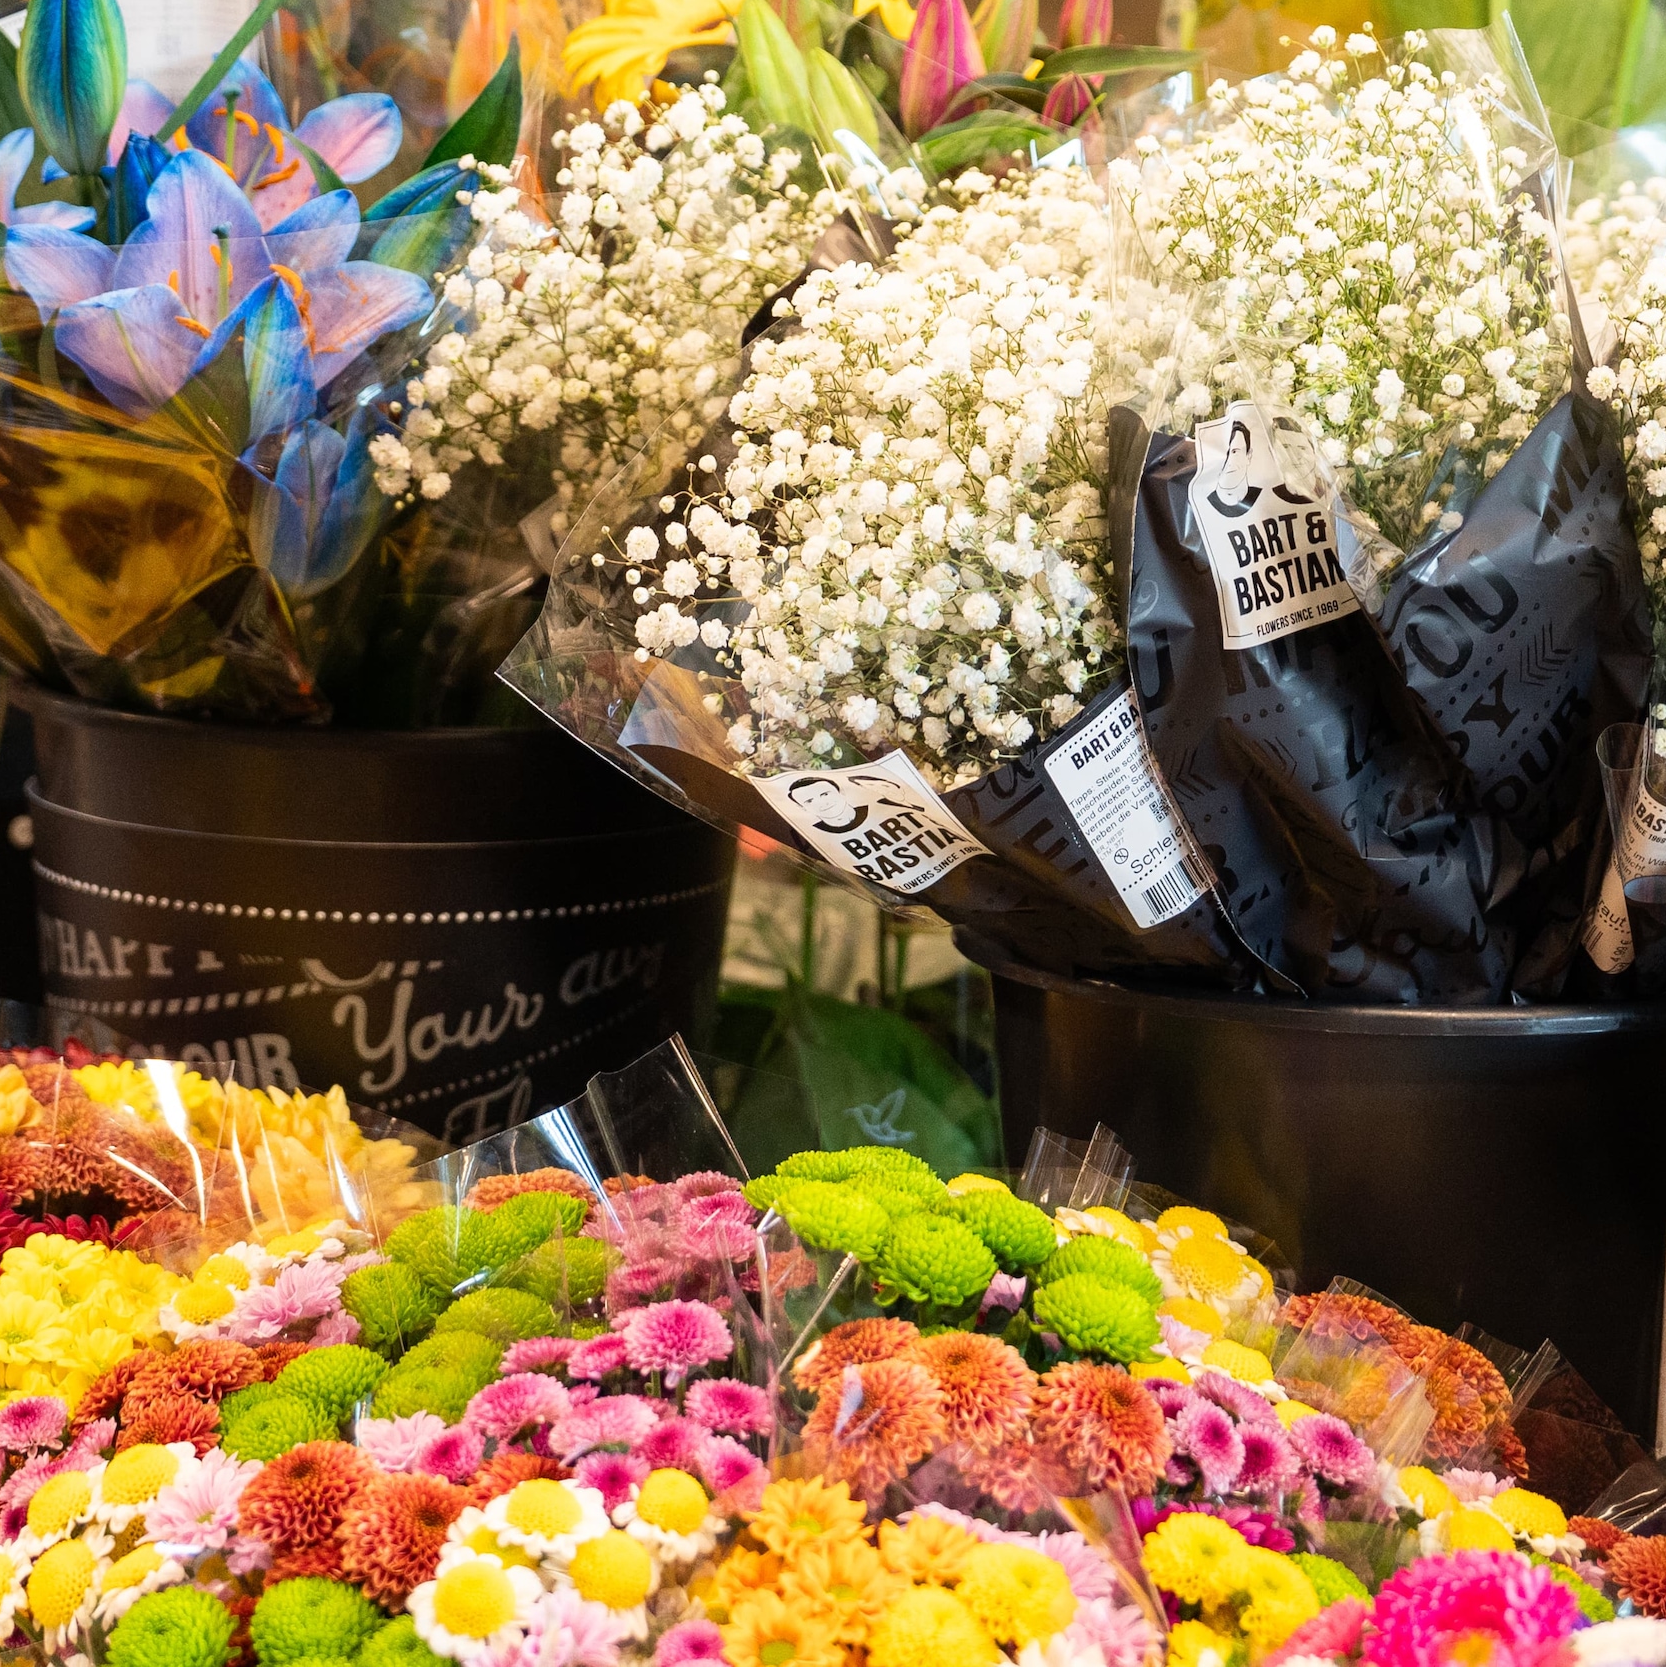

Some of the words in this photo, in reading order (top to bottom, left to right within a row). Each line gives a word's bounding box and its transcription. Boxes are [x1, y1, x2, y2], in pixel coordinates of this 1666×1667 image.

[1227, 513, 1297, 568] BART
[1305, 511, 1327, 544] &
[1233, 547, 1347, 616] BASTIAN
[1256, 615, 1290, 637] FLOWERS
[1290, 607, 1315, 626] SINCE
[1316, 599, 1339, 617] 1969
[1070, 729, 1111, 770] BART
[1109, 721, 1123, 739] &
[1103, 735, 1131, 763] FLOWERS
[1069, 786, 1096, 809] Tipps:
[1095, 765, 1121, 787] Stiele
[1075, 774, 1131, 819] anschneiden,
[1080, 811, 1096, 827] und
[1097, 784, 1131, 813] direktes
[841, 812, 924, 860] BART
[1090, 821, 1117, 846] neben
[1118, 810, 1131, 823] die
[1131, 791, 1155, 810] Vase
[1648, 834, 1666, 844] 1969
[853, 827, 973, 882] BASTIA
[933, 853, 959, 874] SINCE
[333, 979, 544, 1094] Your
